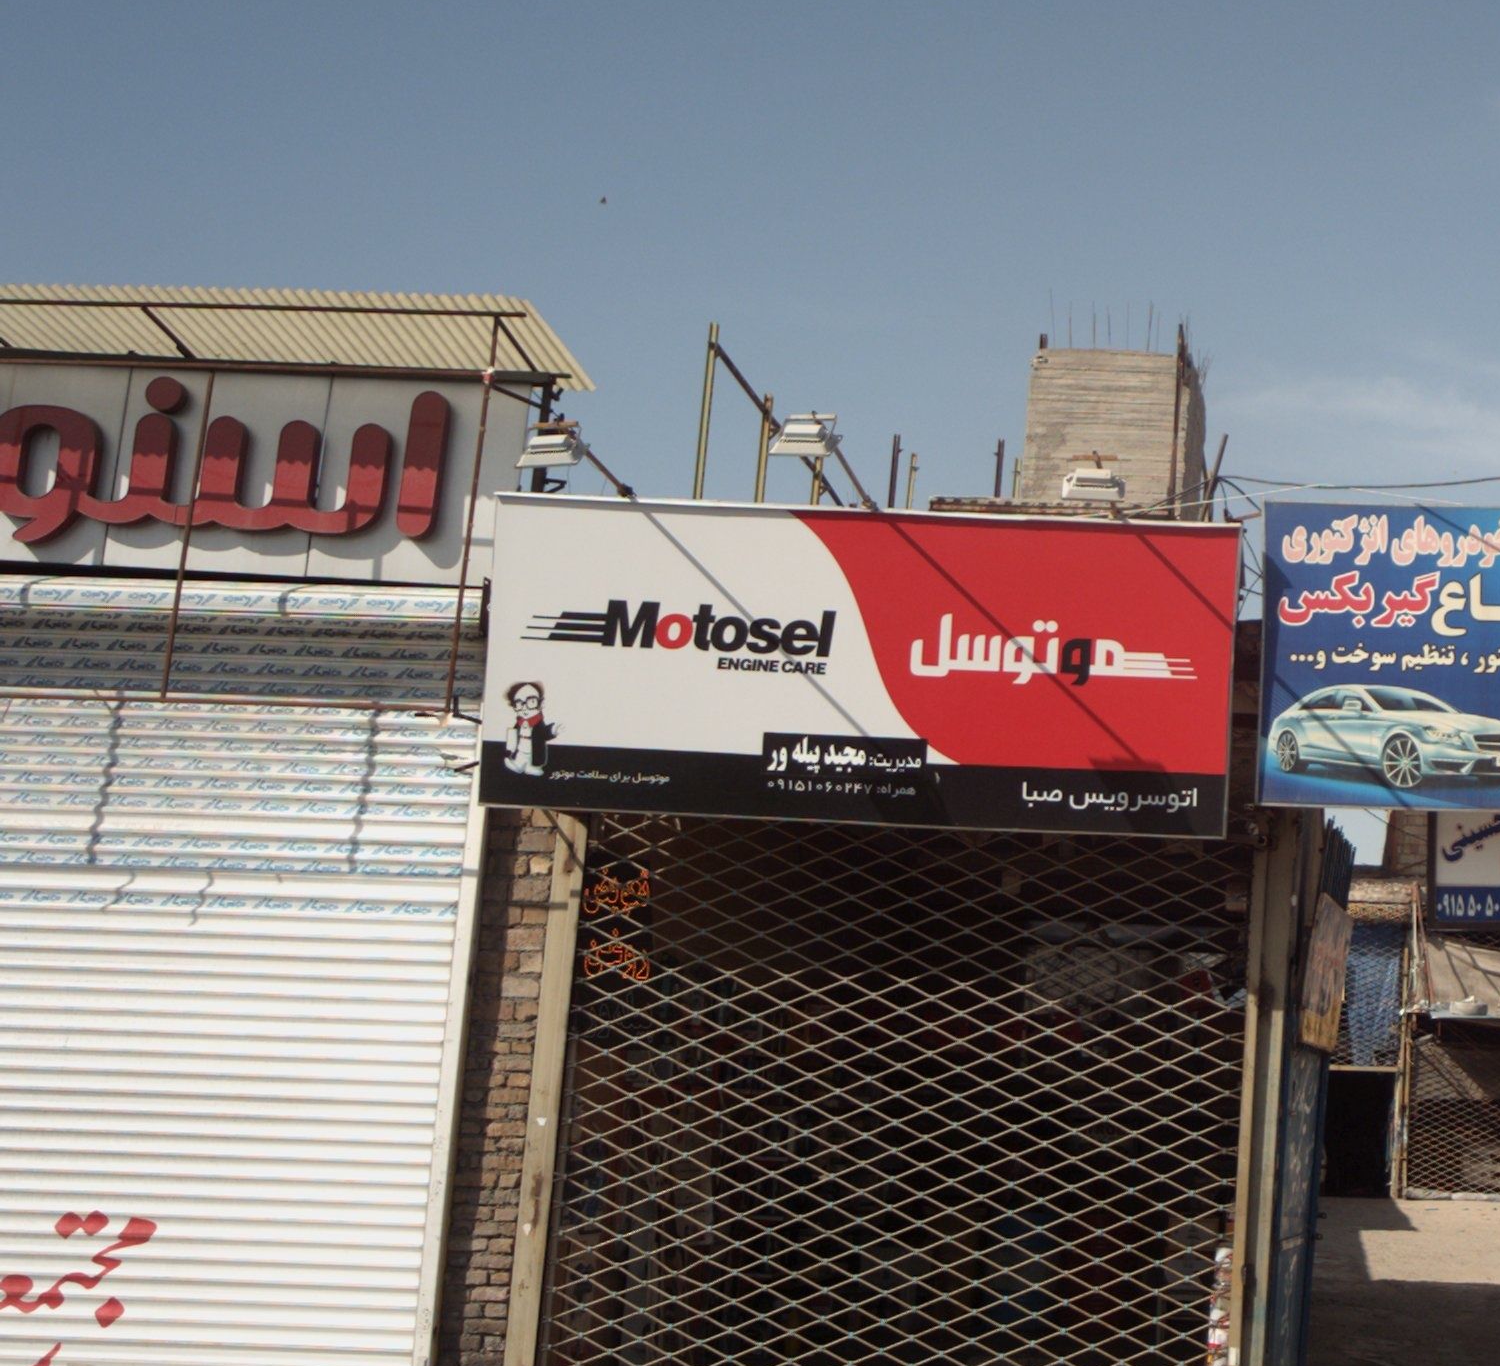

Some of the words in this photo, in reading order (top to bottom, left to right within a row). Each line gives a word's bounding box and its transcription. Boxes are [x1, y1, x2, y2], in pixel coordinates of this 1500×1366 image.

[601, 599, 837, 658] Motosel
[910, 613, 1172, 686] موتوسل
[1331, 642, 1396, 671] سوخت
[1401, 644, 1456, 672] تنظیم
[717, 657, 779, 674] ENGINE
[782, 660, 828, 676] CARE
[824, 740, 867, 773] مجید
[609, 770, 631, 784] برای
[632, 771, 671, 786] موتوسل
[1022, 782, 1064, 808] صبا
